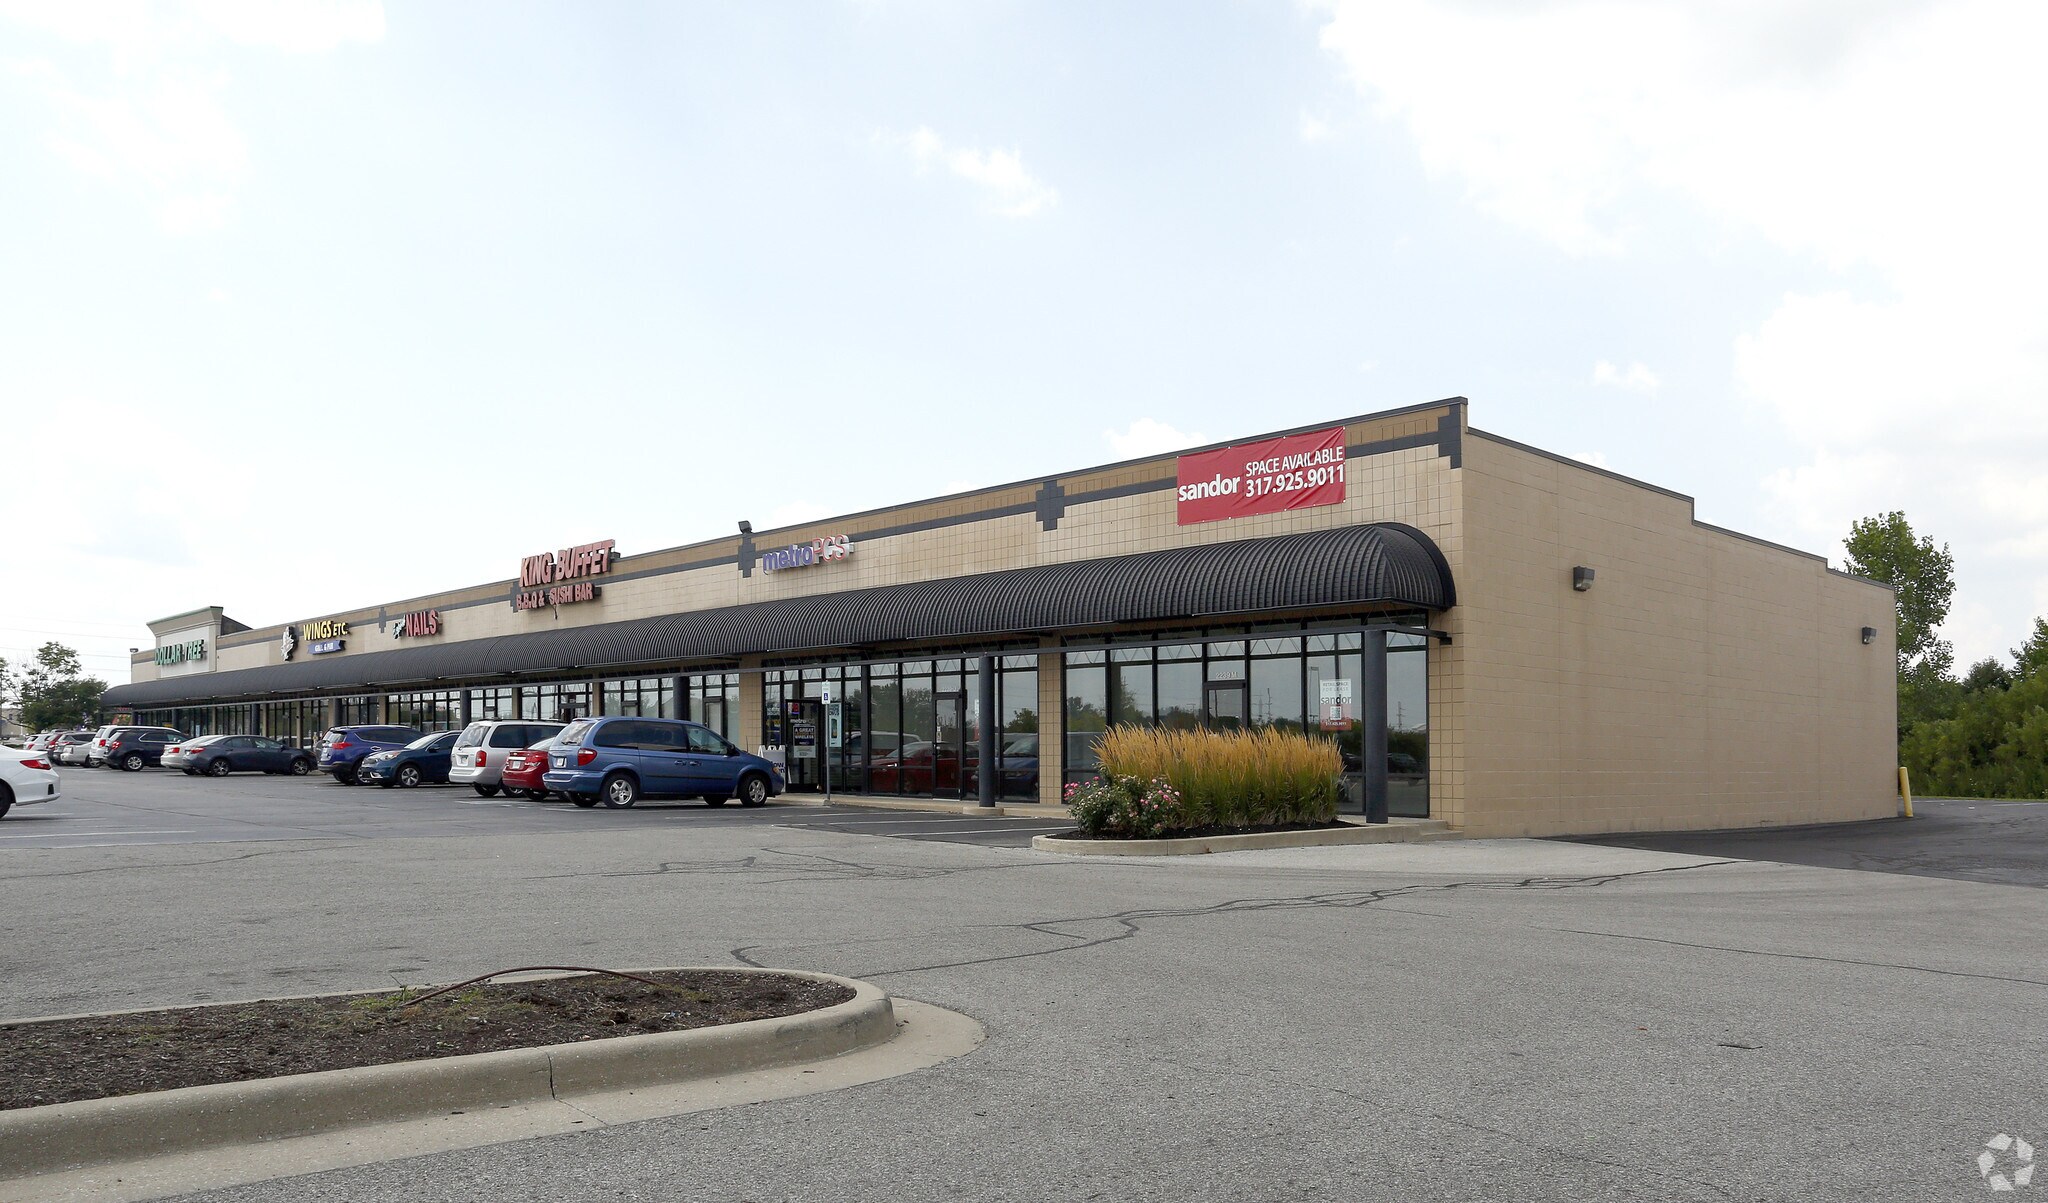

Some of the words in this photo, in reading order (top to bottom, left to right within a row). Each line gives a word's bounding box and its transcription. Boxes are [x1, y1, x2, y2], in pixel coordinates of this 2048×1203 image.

[1246, 457, 1279, 477] SPACE
[1282, 446, 1344, 470] AVAILABLE
[1178, 473, 1241, 502] sandor
[1245, 464, 1344, 497] 317.925.9011
[520, 552, 554, 587] KING
[556, 539, 615, 580] BUFFET
[763, 534, 849, 570] metroPCS
[549, 584, 573, 605] SUSHI
[575, 582, 594, 601] BAR
[303, 620, 333, 641] WINGS
[406, 609, 438, 637] NAILS
[155, 644, 183, 665] DOLLAR
[183, 639, 204, 661] TREE
[1320, 693, 1352, 704] sandor
